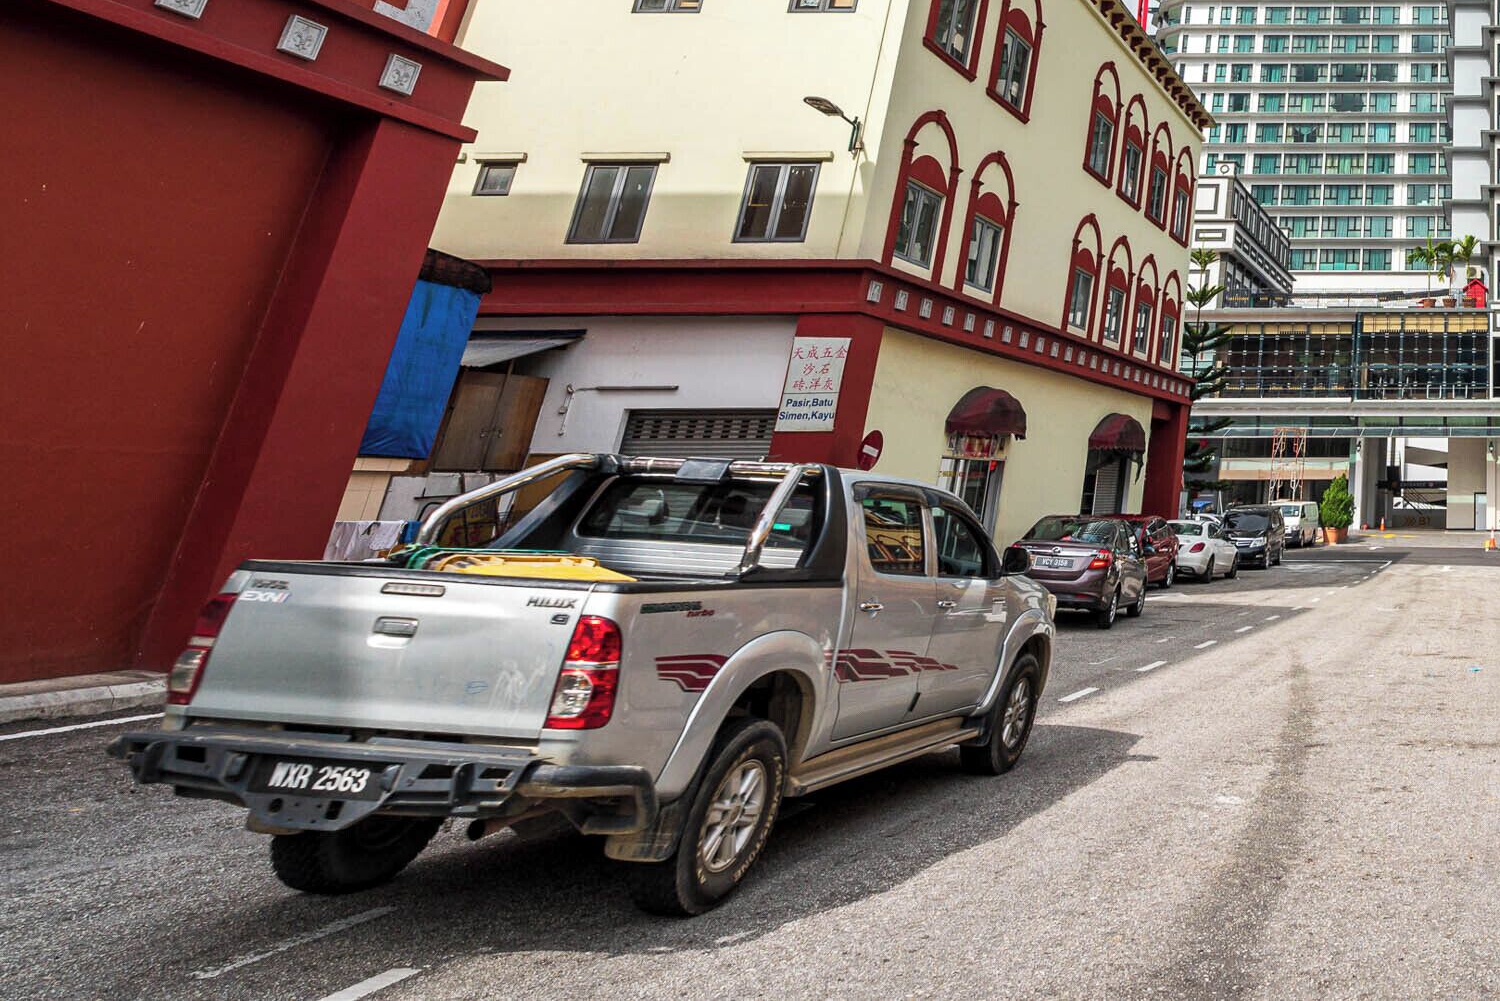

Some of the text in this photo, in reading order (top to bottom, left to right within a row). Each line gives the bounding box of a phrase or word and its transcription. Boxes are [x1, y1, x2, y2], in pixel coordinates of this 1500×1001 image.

[527, 597, 577, 609] HILUX
[267, 762, 371, 793] WXR 2563
